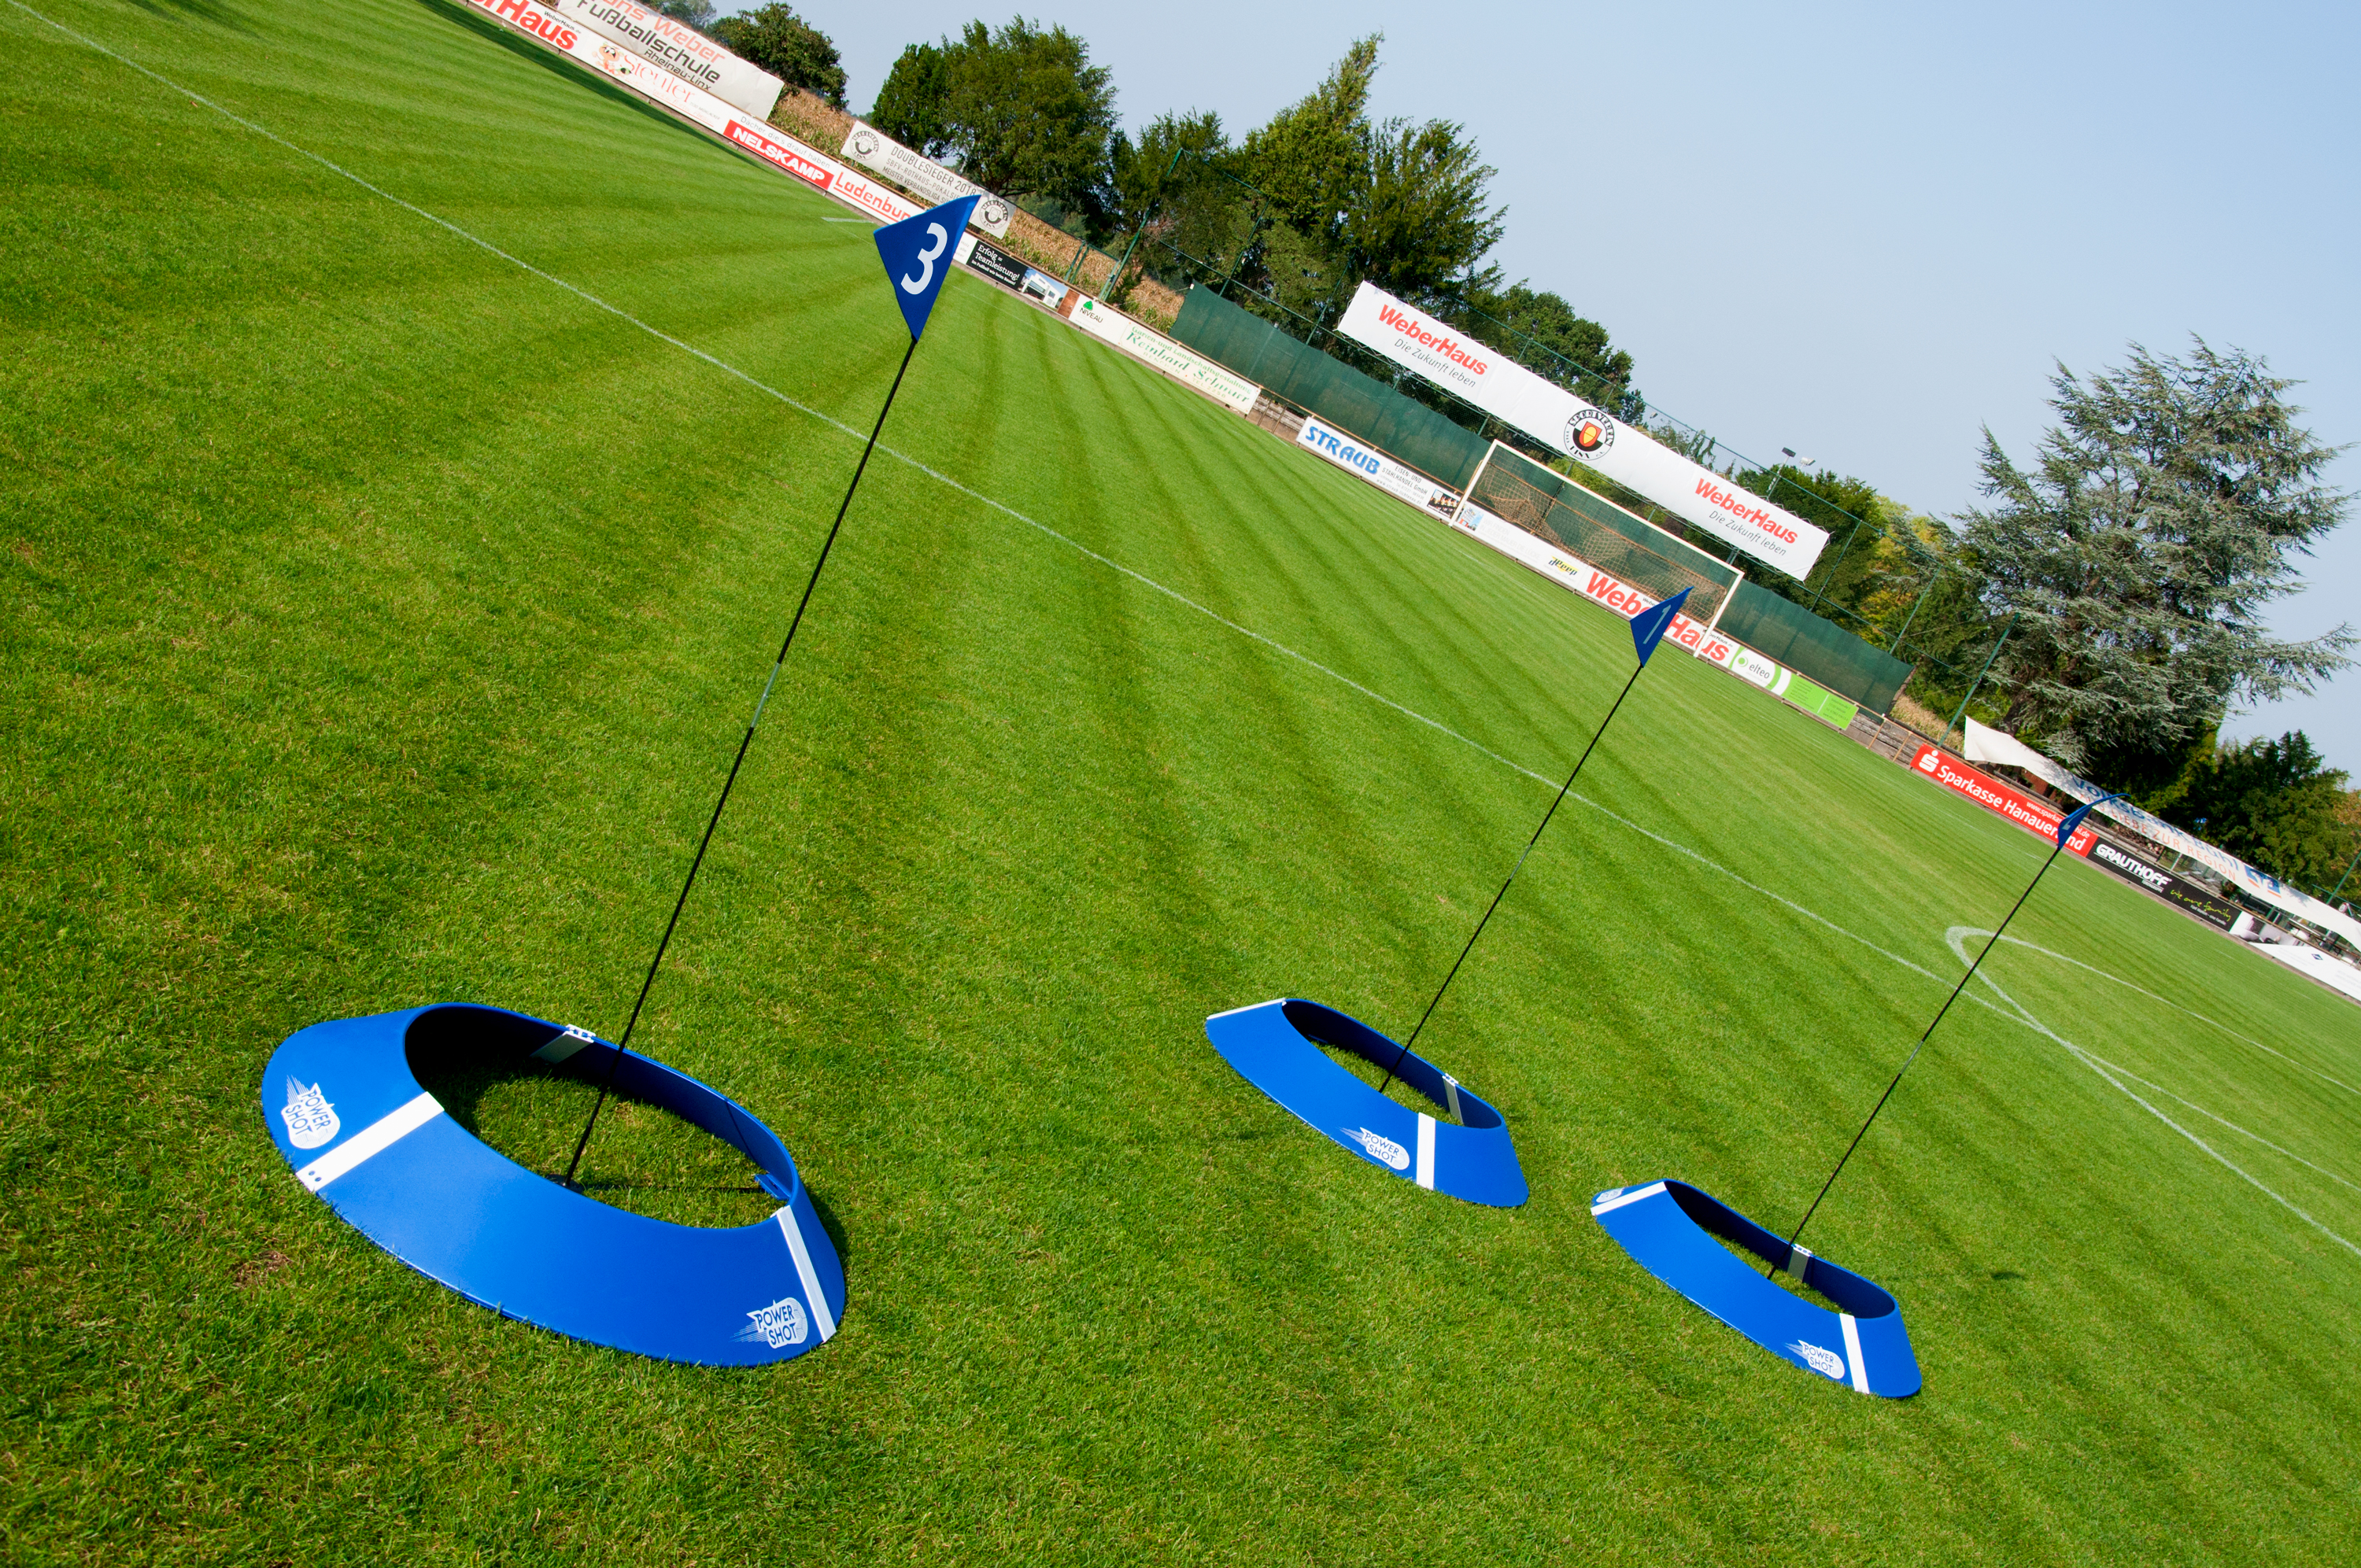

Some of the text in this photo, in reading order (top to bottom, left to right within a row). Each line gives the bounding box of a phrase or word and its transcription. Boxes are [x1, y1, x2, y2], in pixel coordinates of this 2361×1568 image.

[654, 17, 726, 64] Weber
[624, 54, 696, 103] Steuler
[644, 49, 711, 90] Rheinau-Linx
[733, 127, 825, 181] NELSKAMP
[787, 141, 807, 156] drauf
[807, 151, 830, 168] haben
[891, 146, 955, 186] DOUBLESIEGER
[883, 167, 903, 183] MEISTER
[903, 176, 940, 201] VERBANDSLIGA
[900, 222, 948, 295] 3
[975, 252, 1020, 281] Teamleistung!
[977, 245, 997, 261] Erfolg
[1080, 307, 1103, 323] NIVEAU
[1126, 331, 1190, 371] Reinhard
[1379, 304, 1488, 375] WeberHaus
[1173, 348, 1252, 394] Landschaftsgestaltung
[1395, 338, 1476, 388] Die Zukunft leben
[1568, 410, 1613, 446] SPORTVEREIN
[1305, 426, 1380, 475] STRAUB
[1382, 467, 1428, 496] STAHLHANDEL GmbH
[1395, 466, 1422, 484] EISEN- UND
[1694, 478, 1798, 544] WeberHaus
[1709, 511, 1786, 556] Die Zukunft leben
[1585, 571, 1729, 661] WebHaus
[1643, 604, 1672, 644] 1
[1749, 663, 1770, 679] elteo
[1937, 766, 2003, 807] Sparkasse
[2003, 799, 2087, 851] Hanauernd
[2112, 806, 2147, 834] LIEBE
[2153, 828, 2181, 852] ZUR
[2187, 845, 2237, 881] REGION
[2193, 837, 2240, 871] Bühl
[2170, 889, 2232, 922] we are family
[285, 1105, 313, 1135] SHOT
[301, 1089, 331, 1131] POWER
[1364, 1131, 1399, 1155] POWER
[1368, 1144, 1396, 1163] SHOT
[753, 1304, 794, 1329] POWER
[769, 1322, 796, 1345] SHOT
[1803, 1344, 1834, 1363] POWER
[1809, 1356, 1834, 1373] SHOT
